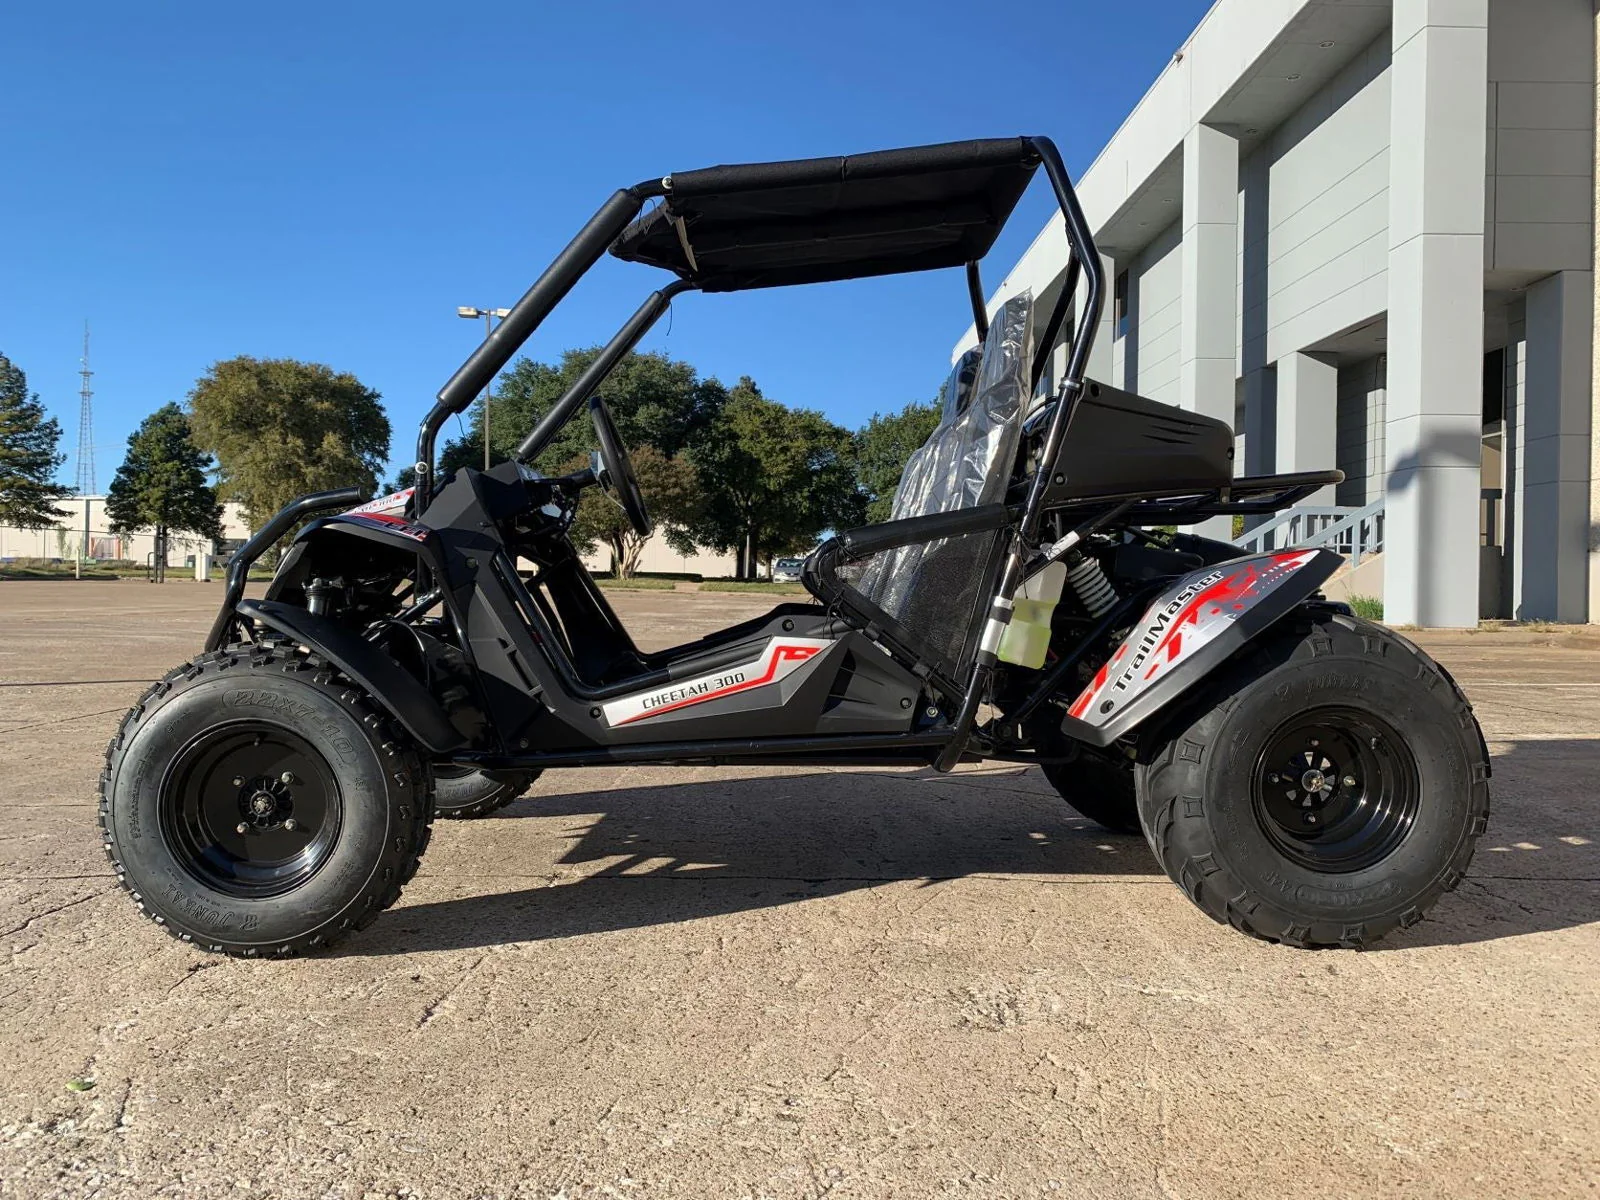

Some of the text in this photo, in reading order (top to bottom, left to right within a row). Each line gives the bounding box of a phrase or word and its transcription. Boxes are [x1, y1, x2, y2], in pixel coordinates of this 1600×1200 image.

[1112, 570, 1223, 692] TrailMaster
[643, 673, 744, 708] CHEETAH 300
